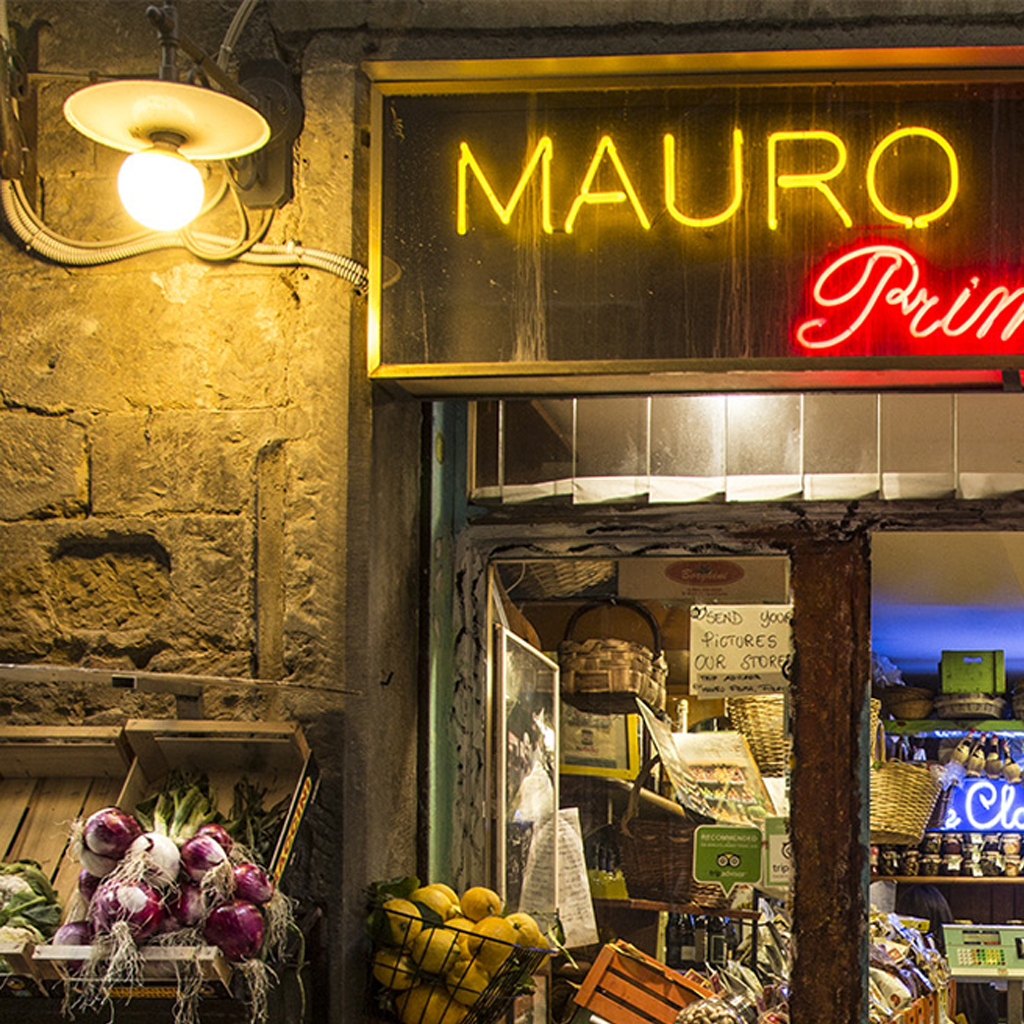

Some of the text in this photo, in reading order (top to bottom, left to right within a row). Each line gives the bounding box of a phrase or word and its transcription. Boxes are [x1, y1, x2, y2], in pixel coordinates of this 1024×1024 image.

[456, 126, 960, 235] MAURO
[705, 610, 743, 625] SEND
[701, 631, 778, 649] PICTURES
[694, 654, 726, 671] OUR
